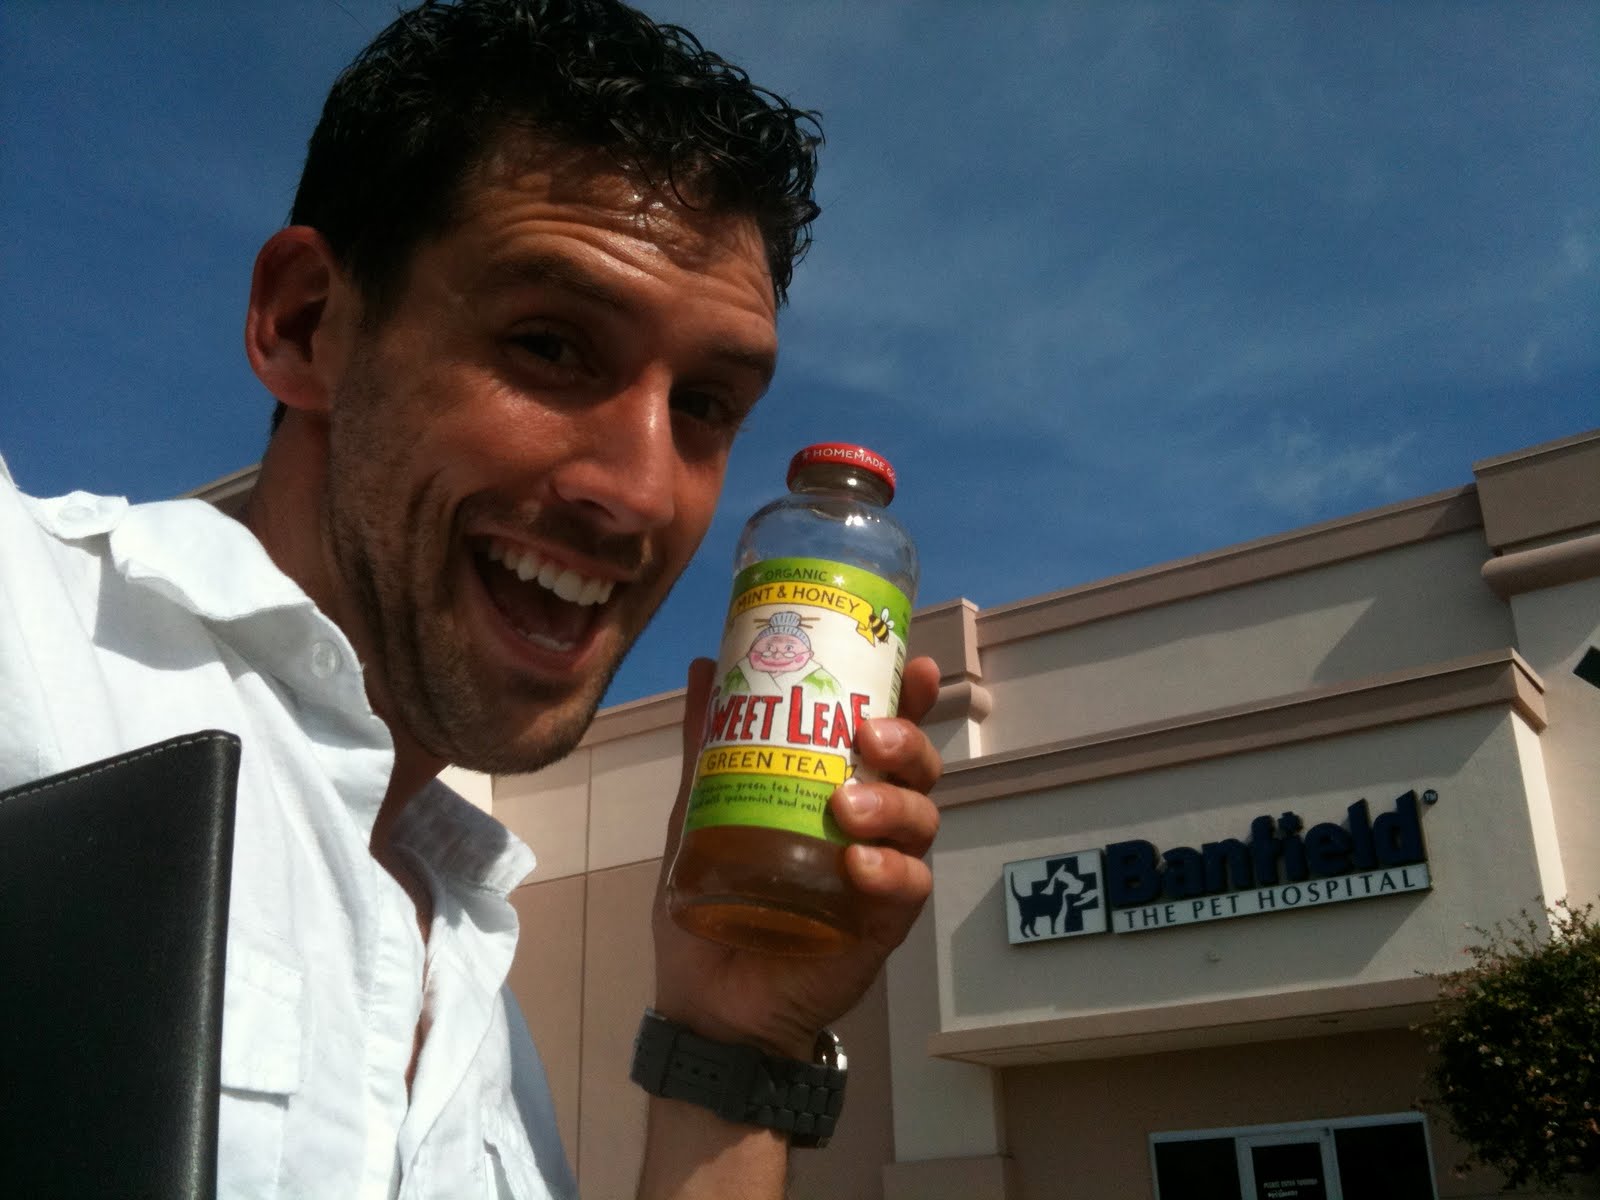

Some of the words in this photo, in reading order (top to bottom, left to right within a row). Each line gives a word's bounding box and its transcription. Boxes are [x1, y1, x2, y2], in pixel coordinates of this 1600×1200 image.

[812, 448, 885, 471] HOMEMADE
[764, 568, 828, 582] ORGANIC
[738, 586, 774, 610] MINT
[777, 585, 788, 599] &
[793, 586, 861, 613] HONEY
[706, 751, 774, 771] GREEN
[782, 753, 827, 777] TEA
[772, 780, 790, 793] tea
[1105, 788, 1429, 908] Banfield
[1124, 904, 1176, 930] THE
[1192, 894, 1241, 920] PET
[1258, 868, 1416, 911] HOSPITAL
